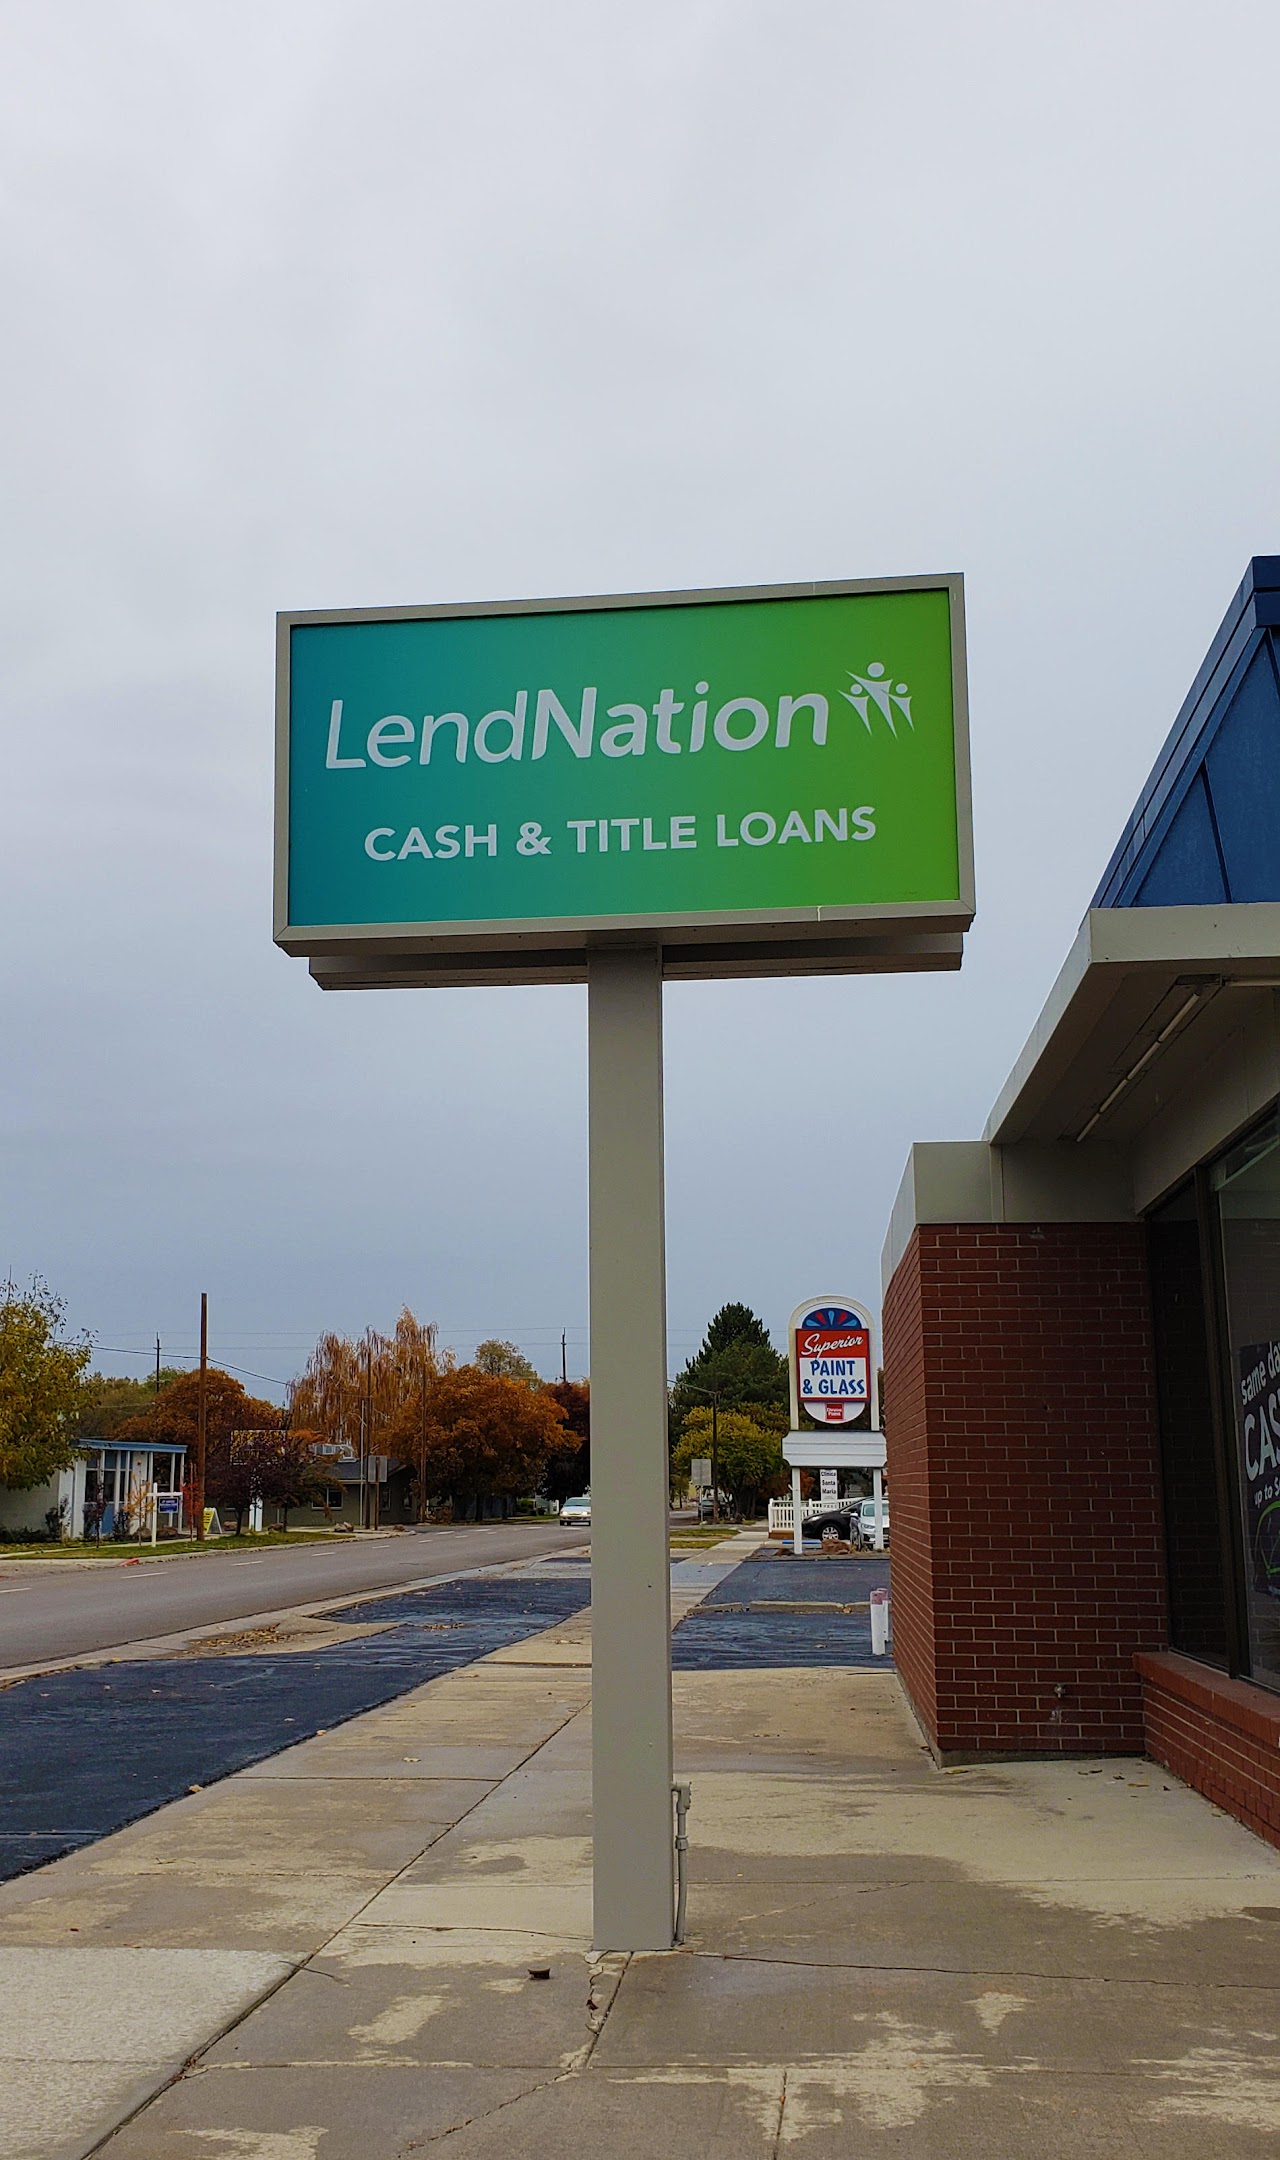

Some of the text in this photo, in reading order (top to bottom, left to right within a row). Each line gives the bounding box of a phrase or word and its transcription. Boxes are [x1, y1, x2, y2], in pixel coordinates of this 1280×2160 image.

[325, 681, 829, 769] LendNation
[364, 806, 876, 861] CASH & TITLE LOANS
[801, 1333, 863, 1360] Superior
[810, 1359, 856, 1376] PAINT
[802, 1379, 865, 1395] & GLASS
[1241, 1360, 1267, 1405] same
[1253, 1490, 1263, 1509] up
[1263, 1484, 1273, 1501] to
